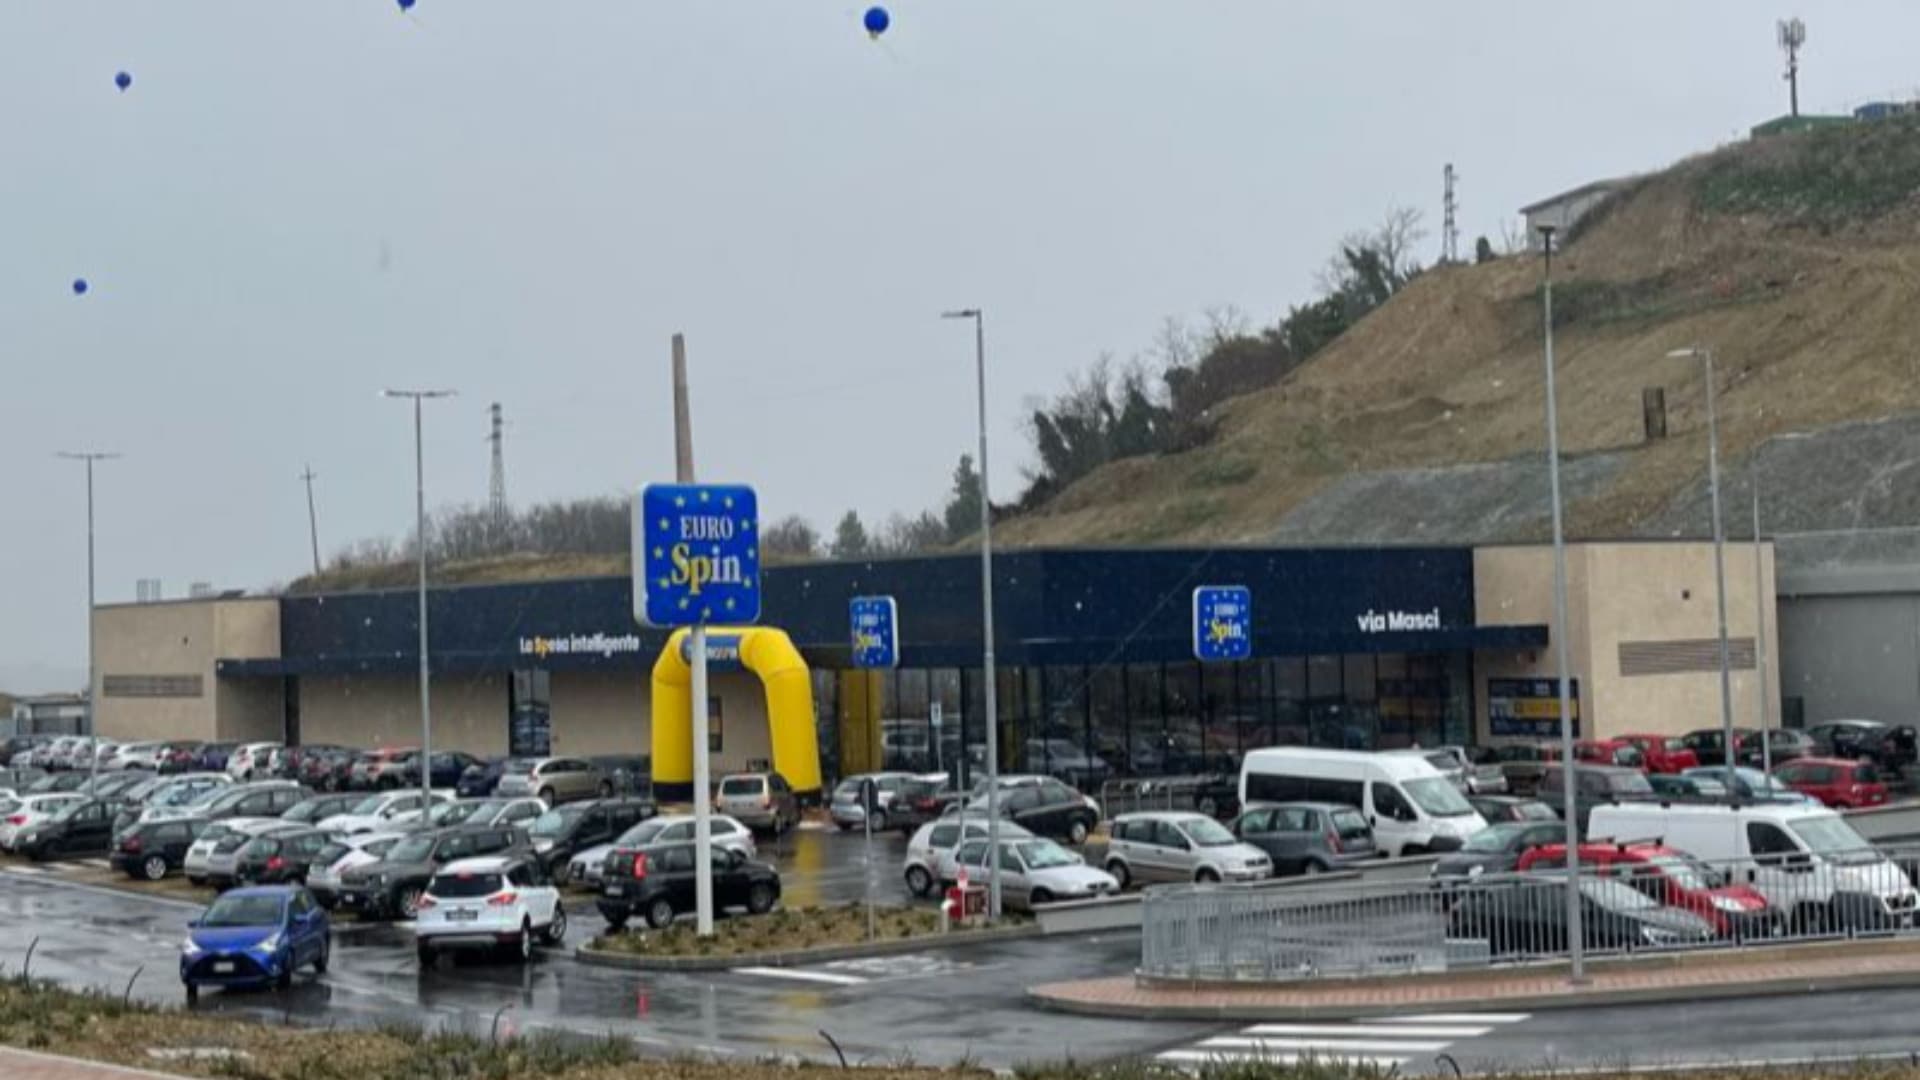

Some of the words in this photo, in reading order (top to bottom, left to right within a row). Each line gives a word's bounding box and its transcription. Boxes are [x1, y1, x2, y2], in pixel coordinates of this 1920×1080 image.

[680, 515, 734, 540] EURO
[670, 542, 742, 595] Spin
[1210, 618, 1242, 645] Spin
[1357, 608, 1385, 632] via
[1388, 606, 1440, 631] Masci
[570, 632, 640, 659] intelligente
